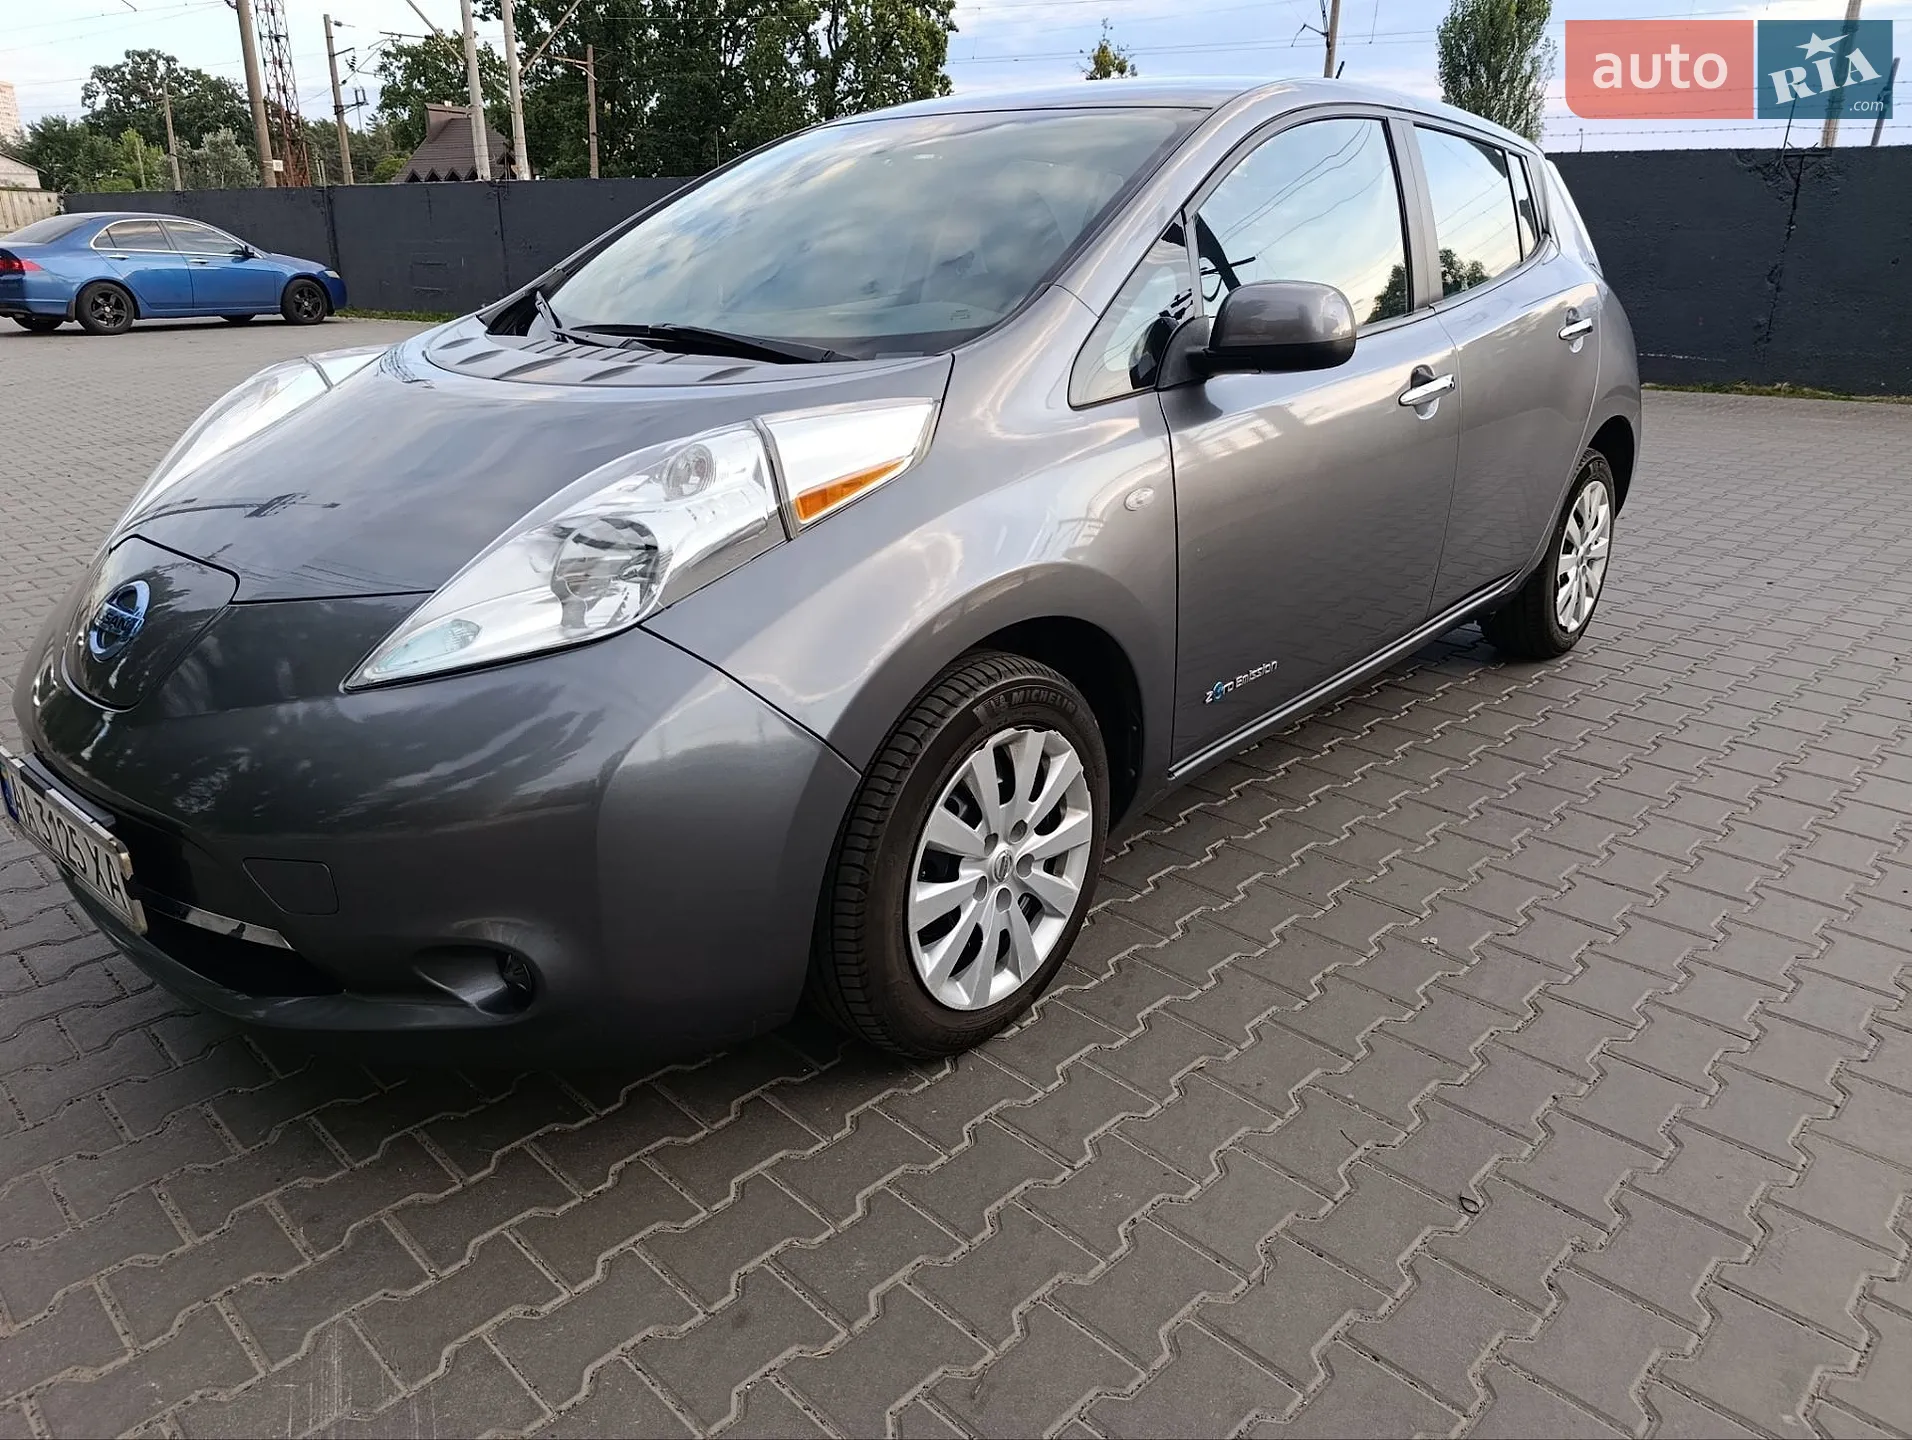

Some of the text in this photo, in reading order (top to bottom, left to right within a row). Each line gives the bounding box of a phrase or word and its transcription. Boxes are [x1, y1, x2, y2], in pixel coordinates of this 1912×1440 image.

[1012, 689, 1077, 714] MICHELIN
[34, 797, 88, 874] 3125
[83, 836, 128, 909] XA
